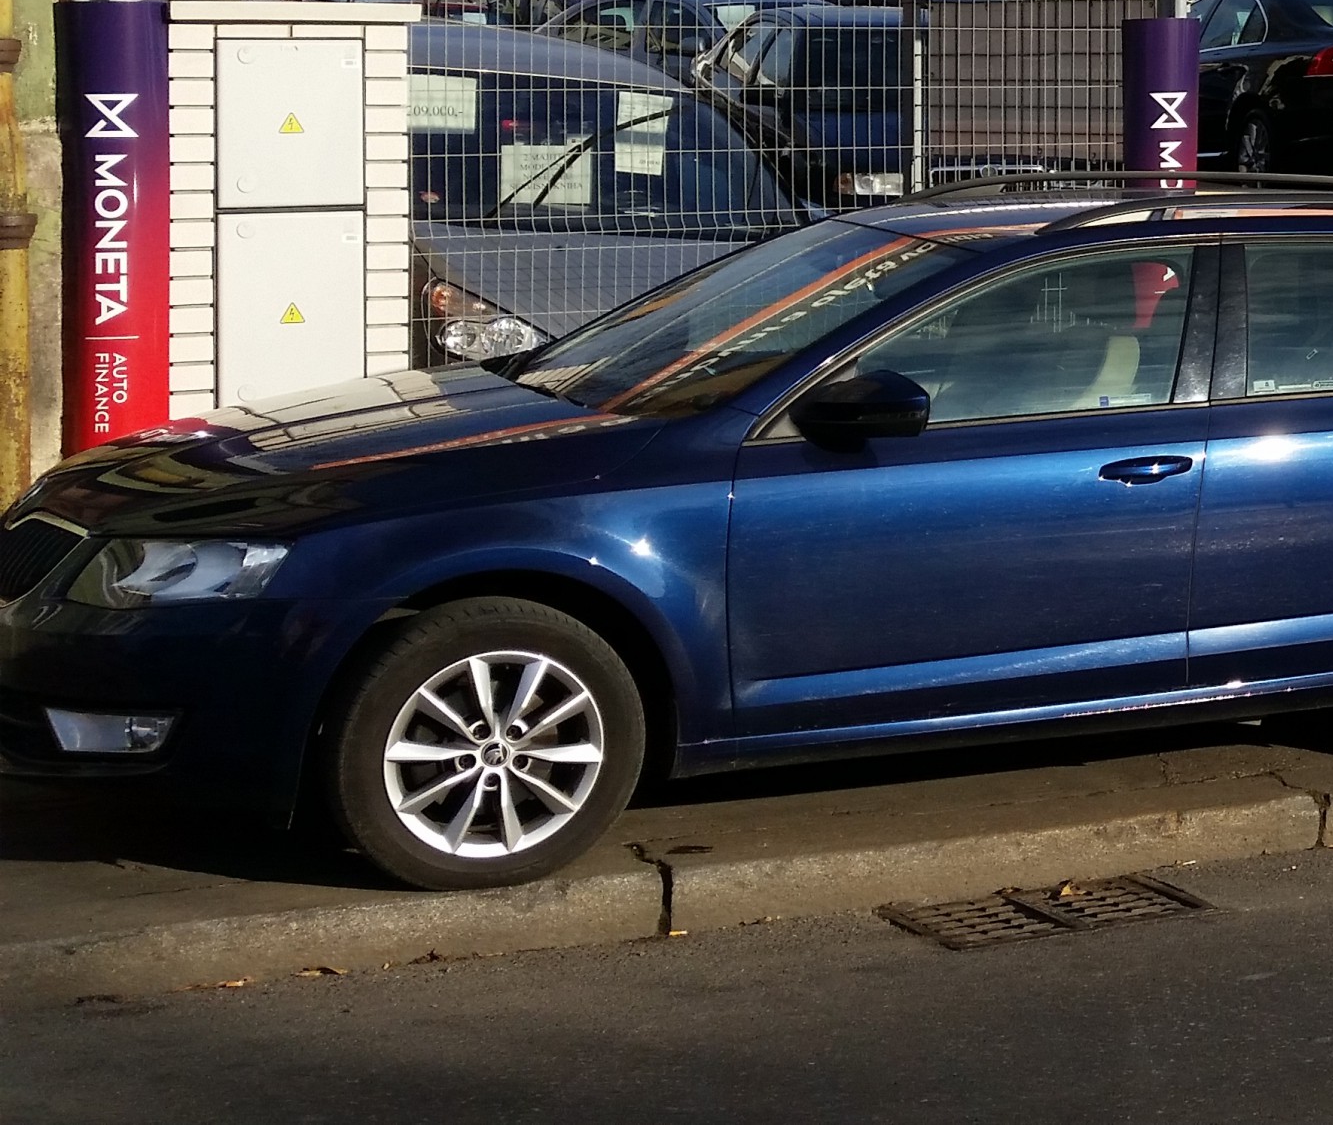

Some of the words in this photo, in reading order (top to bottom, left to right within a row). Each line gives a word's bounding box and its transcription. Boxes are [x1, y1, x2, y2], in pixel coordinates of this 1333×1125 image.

[94, 153, 129, 326] MONETA
[94, 352, 110, 434] FINANCE
[112, 352, 128, 405] AUTO
